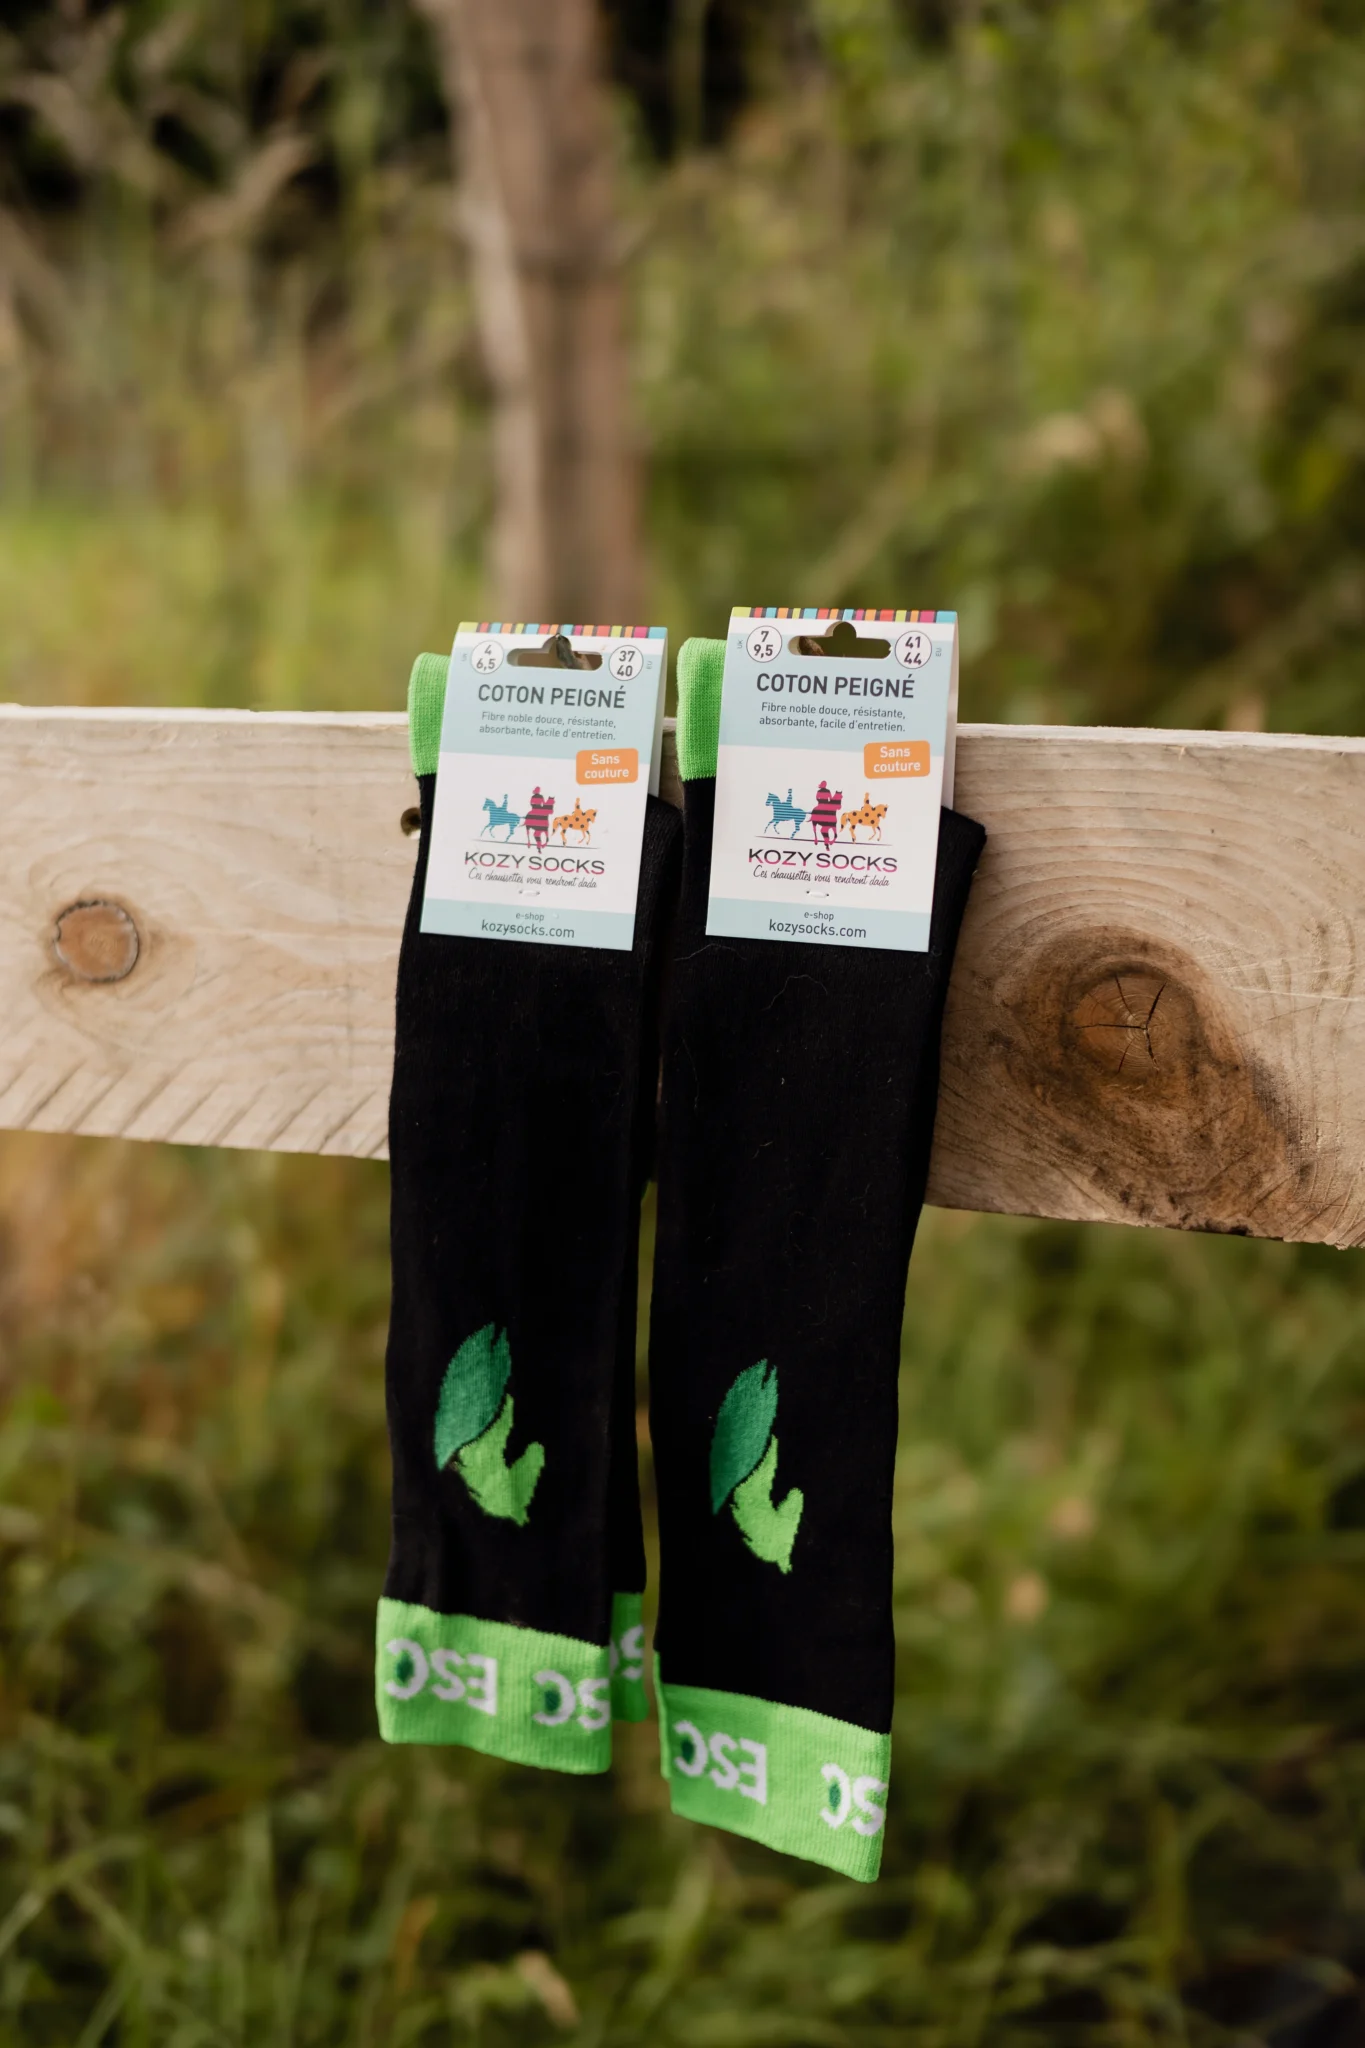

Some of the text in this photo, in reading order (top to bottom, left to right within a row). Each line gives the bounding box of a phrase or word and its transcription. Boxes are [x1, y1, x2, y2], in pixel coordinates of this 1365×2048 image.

[760, 630, 769, 642] 7
[905, 636, 921, 648] 41
[484, 644, 492, 654] 4
[618, 650, 636, 662] 37
[754, 644, 773, 658] 9,5
[476, 658, 496, 670] 6,5
[904, 652, 922, 664] 44
[616, 664, 633, 676] 40
[756, 673, 915, 698] COTON PEIGNÉ
[478, 684, 626, 708] COTON PEIGNÉ
[761, 702, 906, 720] Fibre noble douce, résistante,
[482, 712, 616, 728] Fibre noble douce, résistante,
[760, 716, 906, 732] absorbante, facile d'entretien.
[479, 724, 616, 740] absorbante, facile d'entretien.
[592, 754, 620, 765] Sans
[880, 746, 910, 758] Sans
[584, 766, 629, 778] couture
[874, 760, 920, 772] couture
[464, 852, 605, 874] KOZY SOCKS
[748, 848, 898, 873] KOZY SOCKS
[468, 868, 598, 888] Ces chaussettes vous rendront dada
[753, 864, 890, 886] Ces chaussettes vous rendront dada
[516, 912, 544, 922] e-shop
[804, 911, 834, 921] e-shop
[482, 920, 574, 938] kozysocks.com
[769, 919, 866, 938] kozysocks.com
[385, 1638, 498, 1716] ESC
[674, 1720, 768, 1805] ESC
